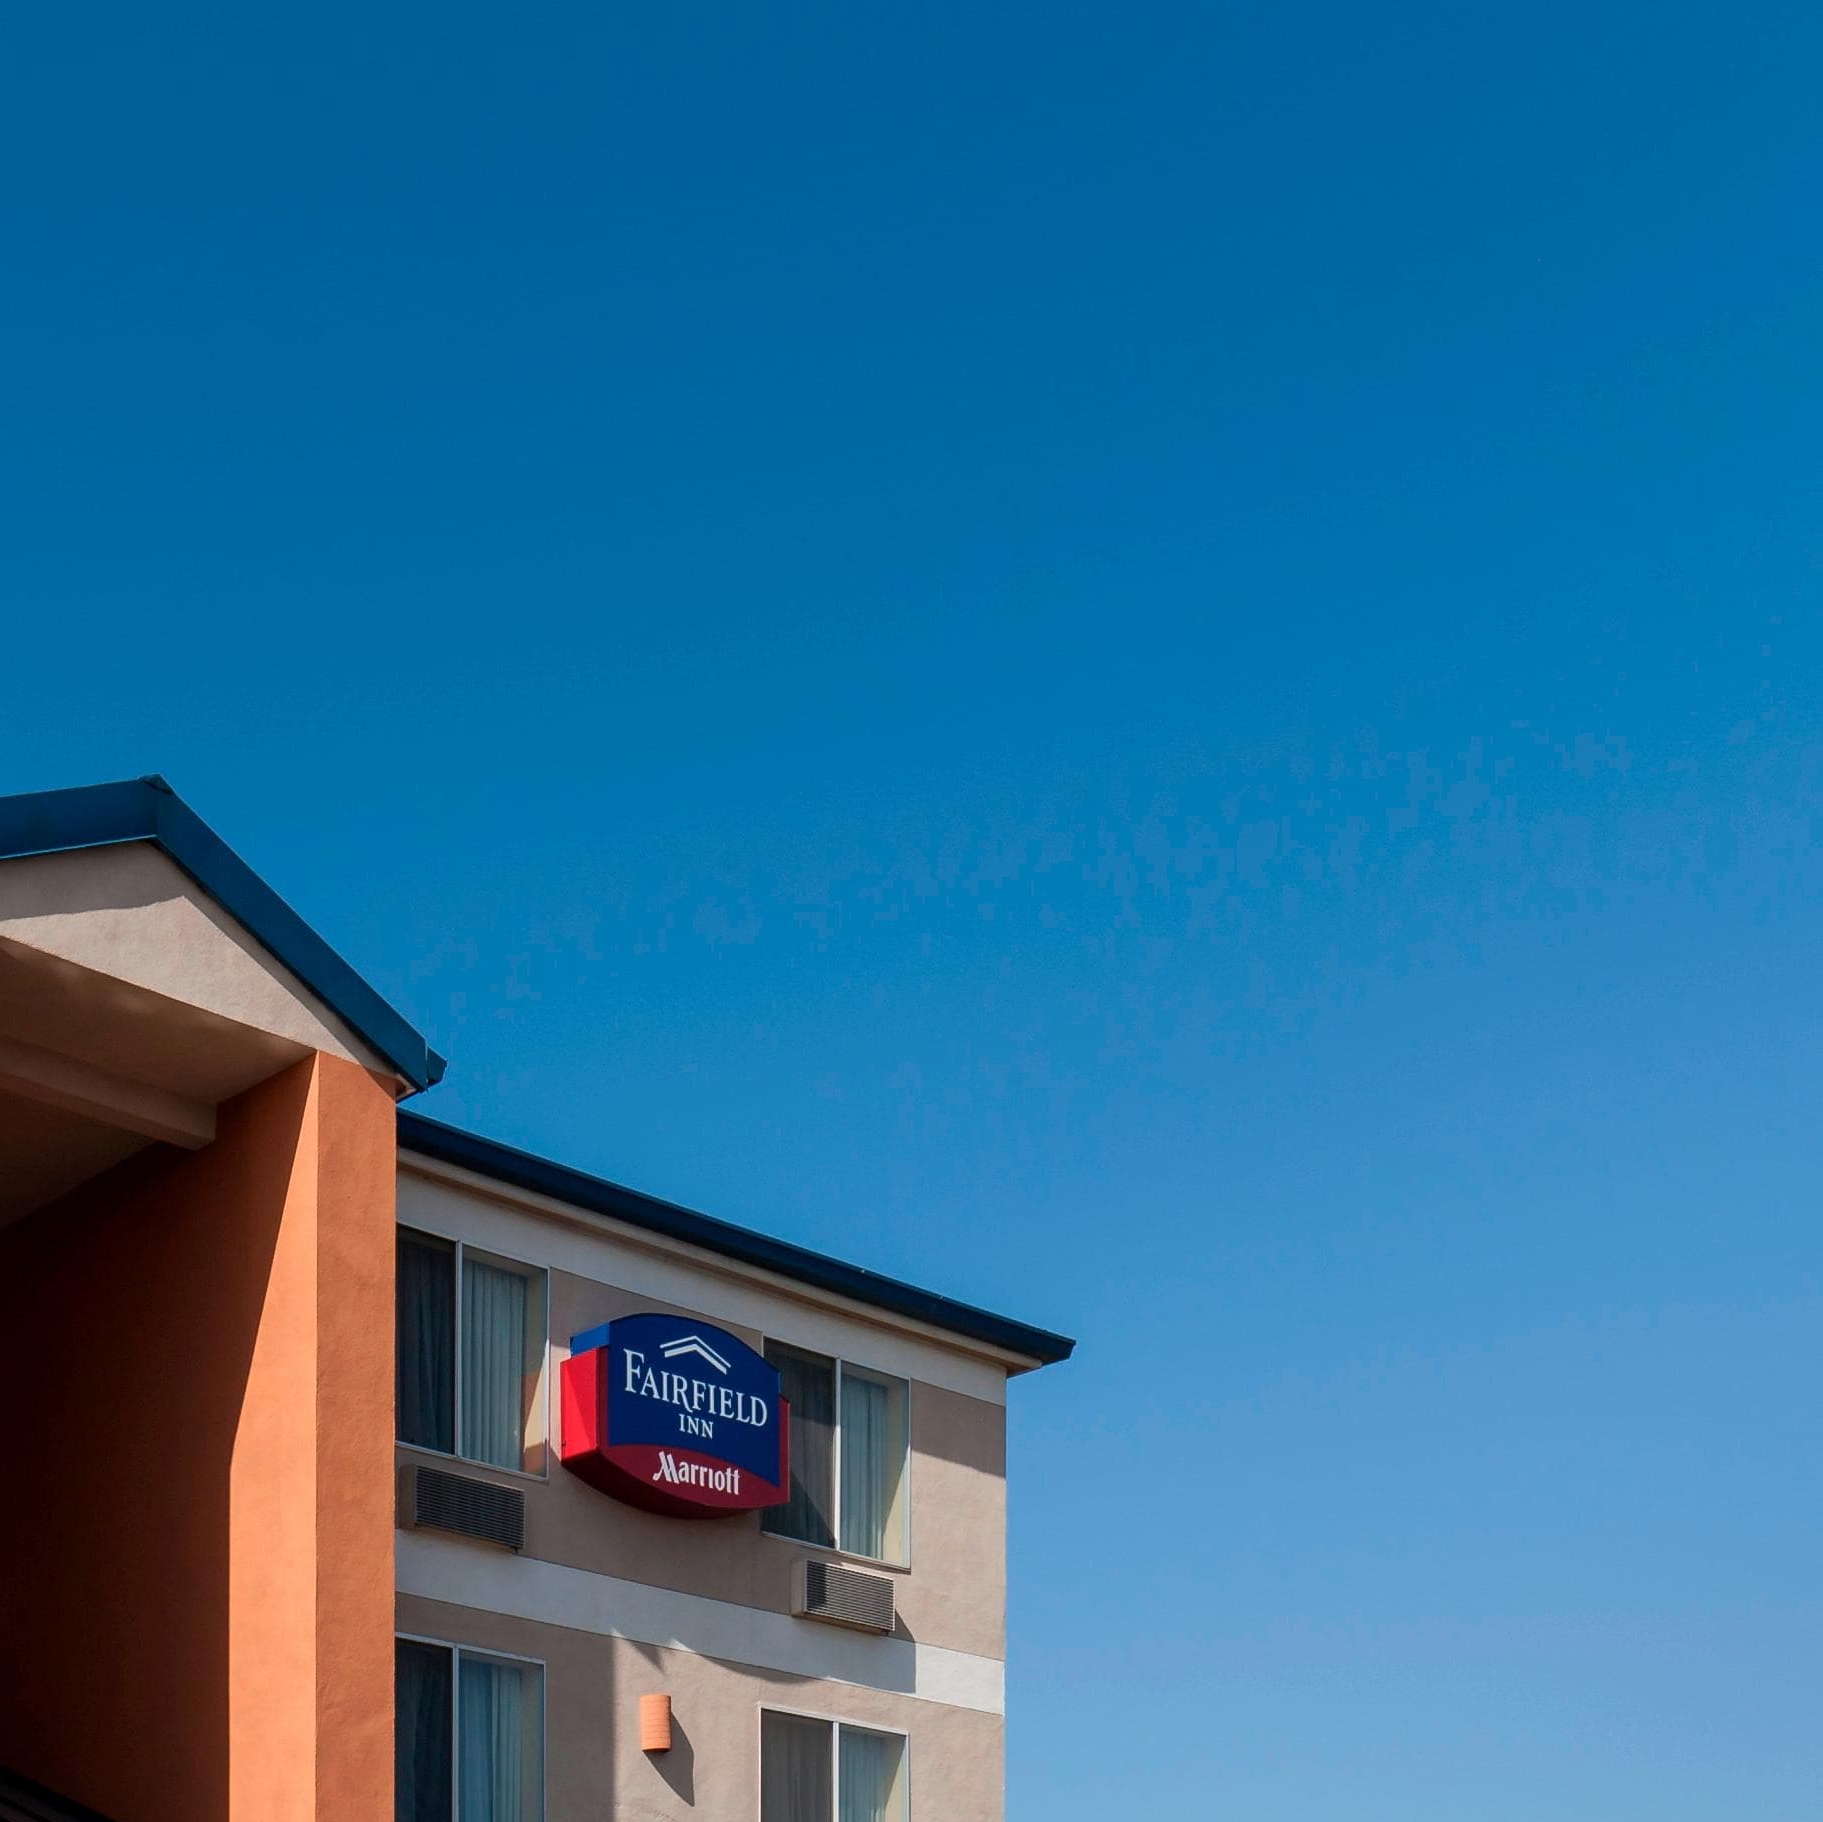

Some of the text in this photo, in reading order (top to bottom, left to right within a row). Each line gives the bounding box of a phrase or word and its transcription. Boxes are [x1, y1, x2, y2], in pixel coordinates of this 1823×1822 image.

[623, 1348, 768, 1428] FAIRFIELD
[679, 1413, 714, 1440] INN
[652, 1450, 740, 1496] Marriott
